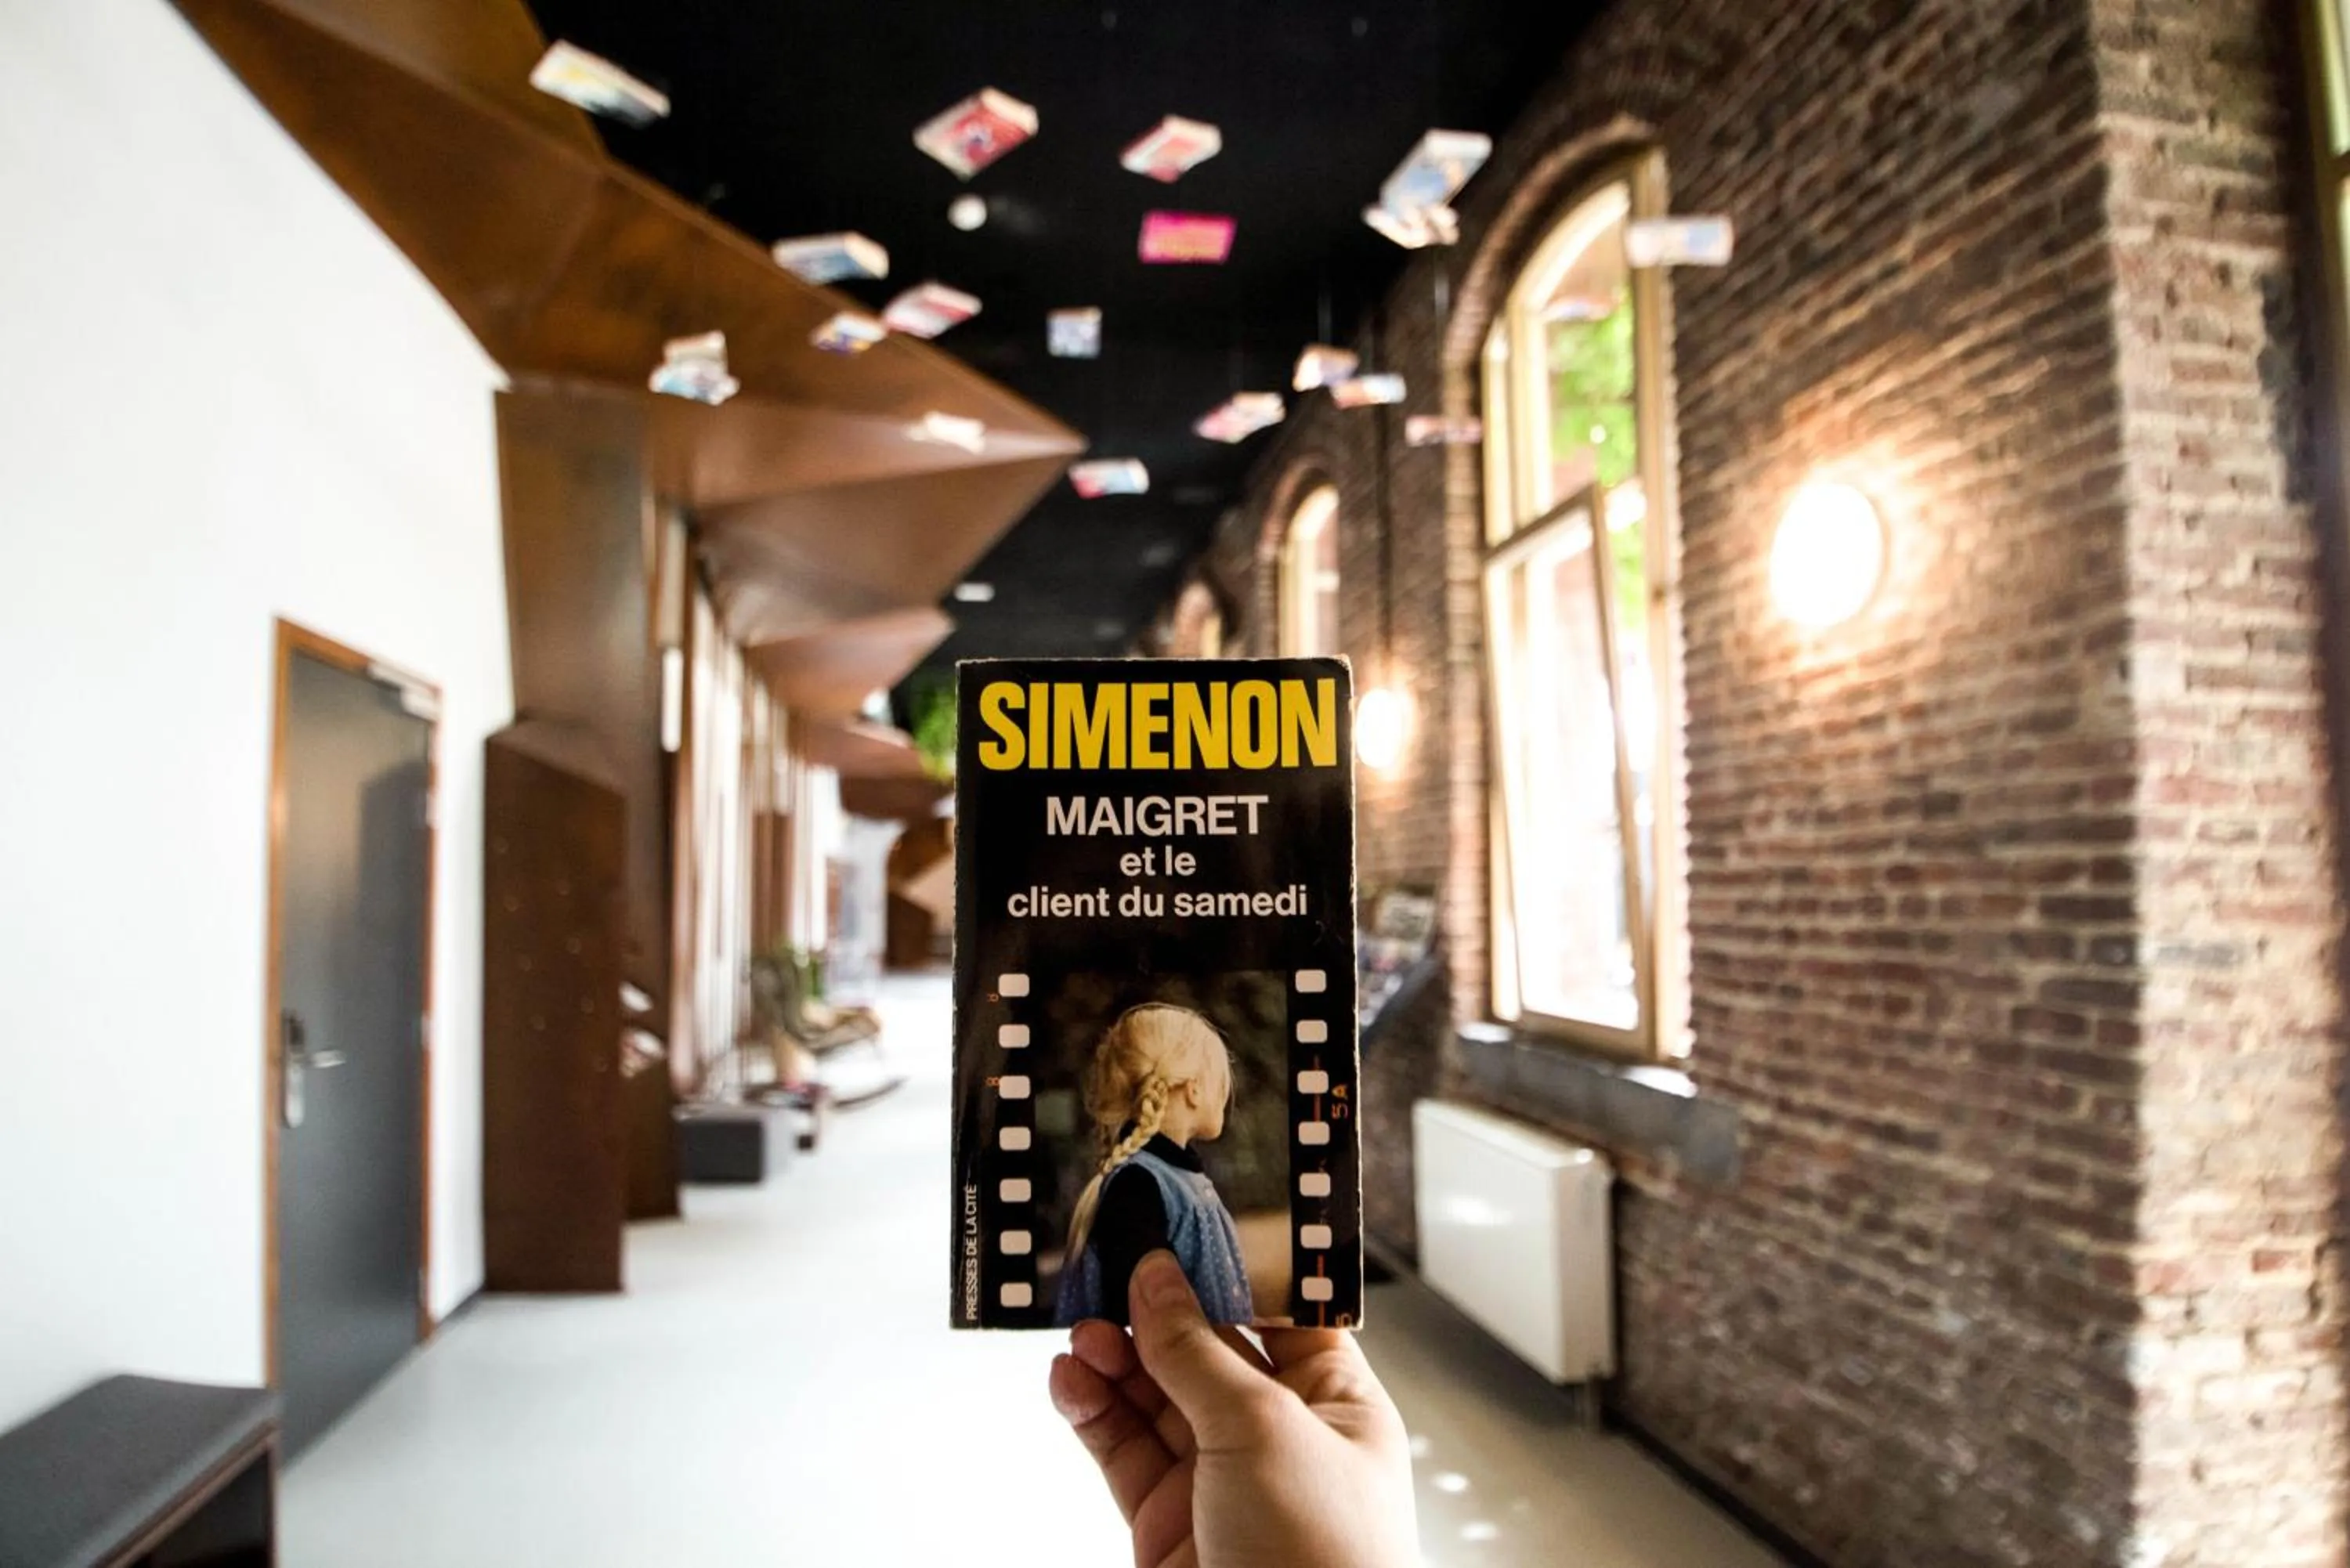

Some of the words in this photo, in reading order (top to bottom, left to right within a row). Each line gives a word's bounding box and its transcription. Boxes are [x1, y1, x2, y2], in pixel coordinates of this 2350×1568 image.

[978, 677, 1338, 771] SIMENON
[1047, 794, 1269, 836] MAIGRET
[1119, 847, 1156, 876] et
[1165, 845, 1196, 876] le
[1007, 886, 1110, 917] client
[1118, 885, 1164, 917] du
[1174, 884, 1307, 917] samedi
[966, 1216, 977, 1235] LA
[966, 1237, 977, 1255] DE
[966, 1259, 978, 1321] PRESSES
